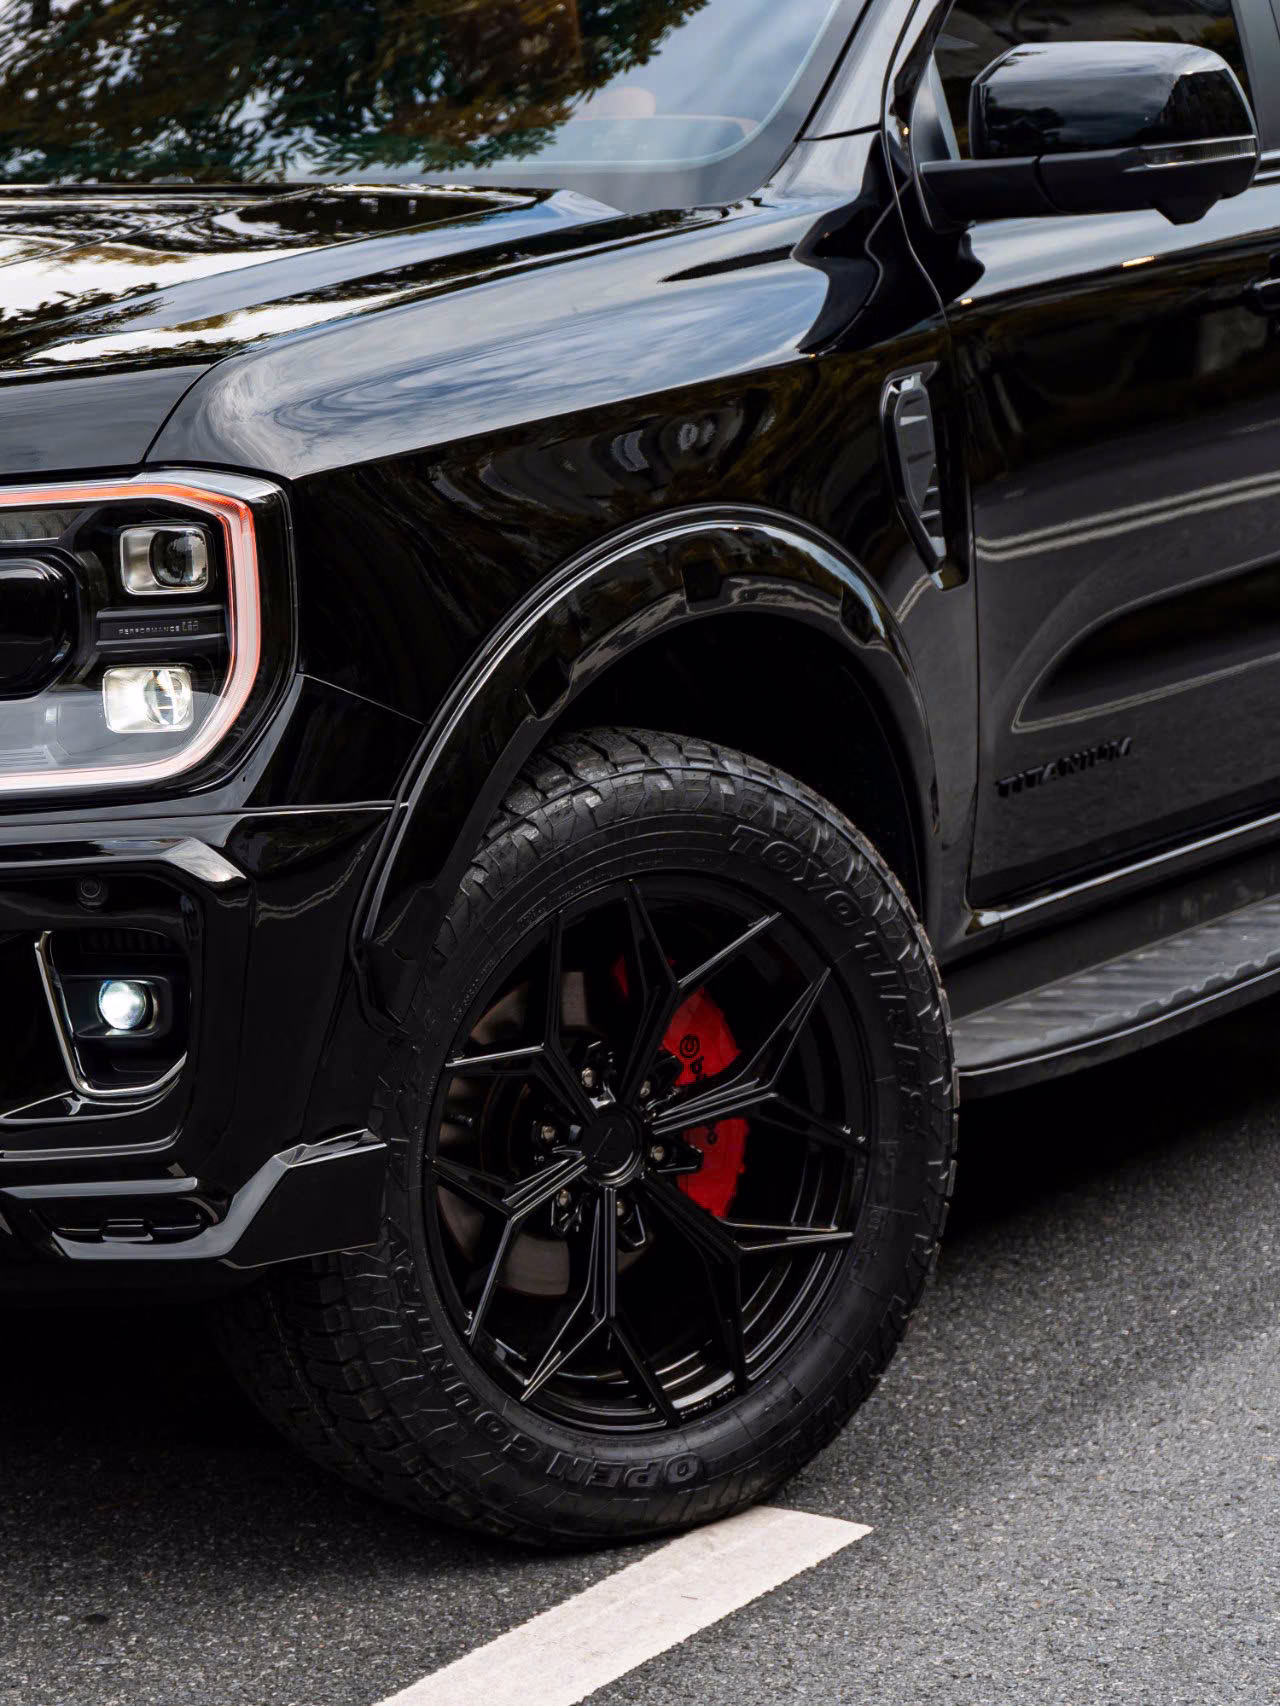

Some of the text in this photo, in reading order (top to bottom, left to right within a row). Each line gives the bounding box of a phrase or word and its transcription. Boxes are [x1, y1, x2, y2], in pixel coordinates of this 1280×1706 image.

[118, 625, 180, 636] PERFORMANCE
[728, 824, 866, 928] TOYO
[545, 1451, 705, 1489] OPEN
